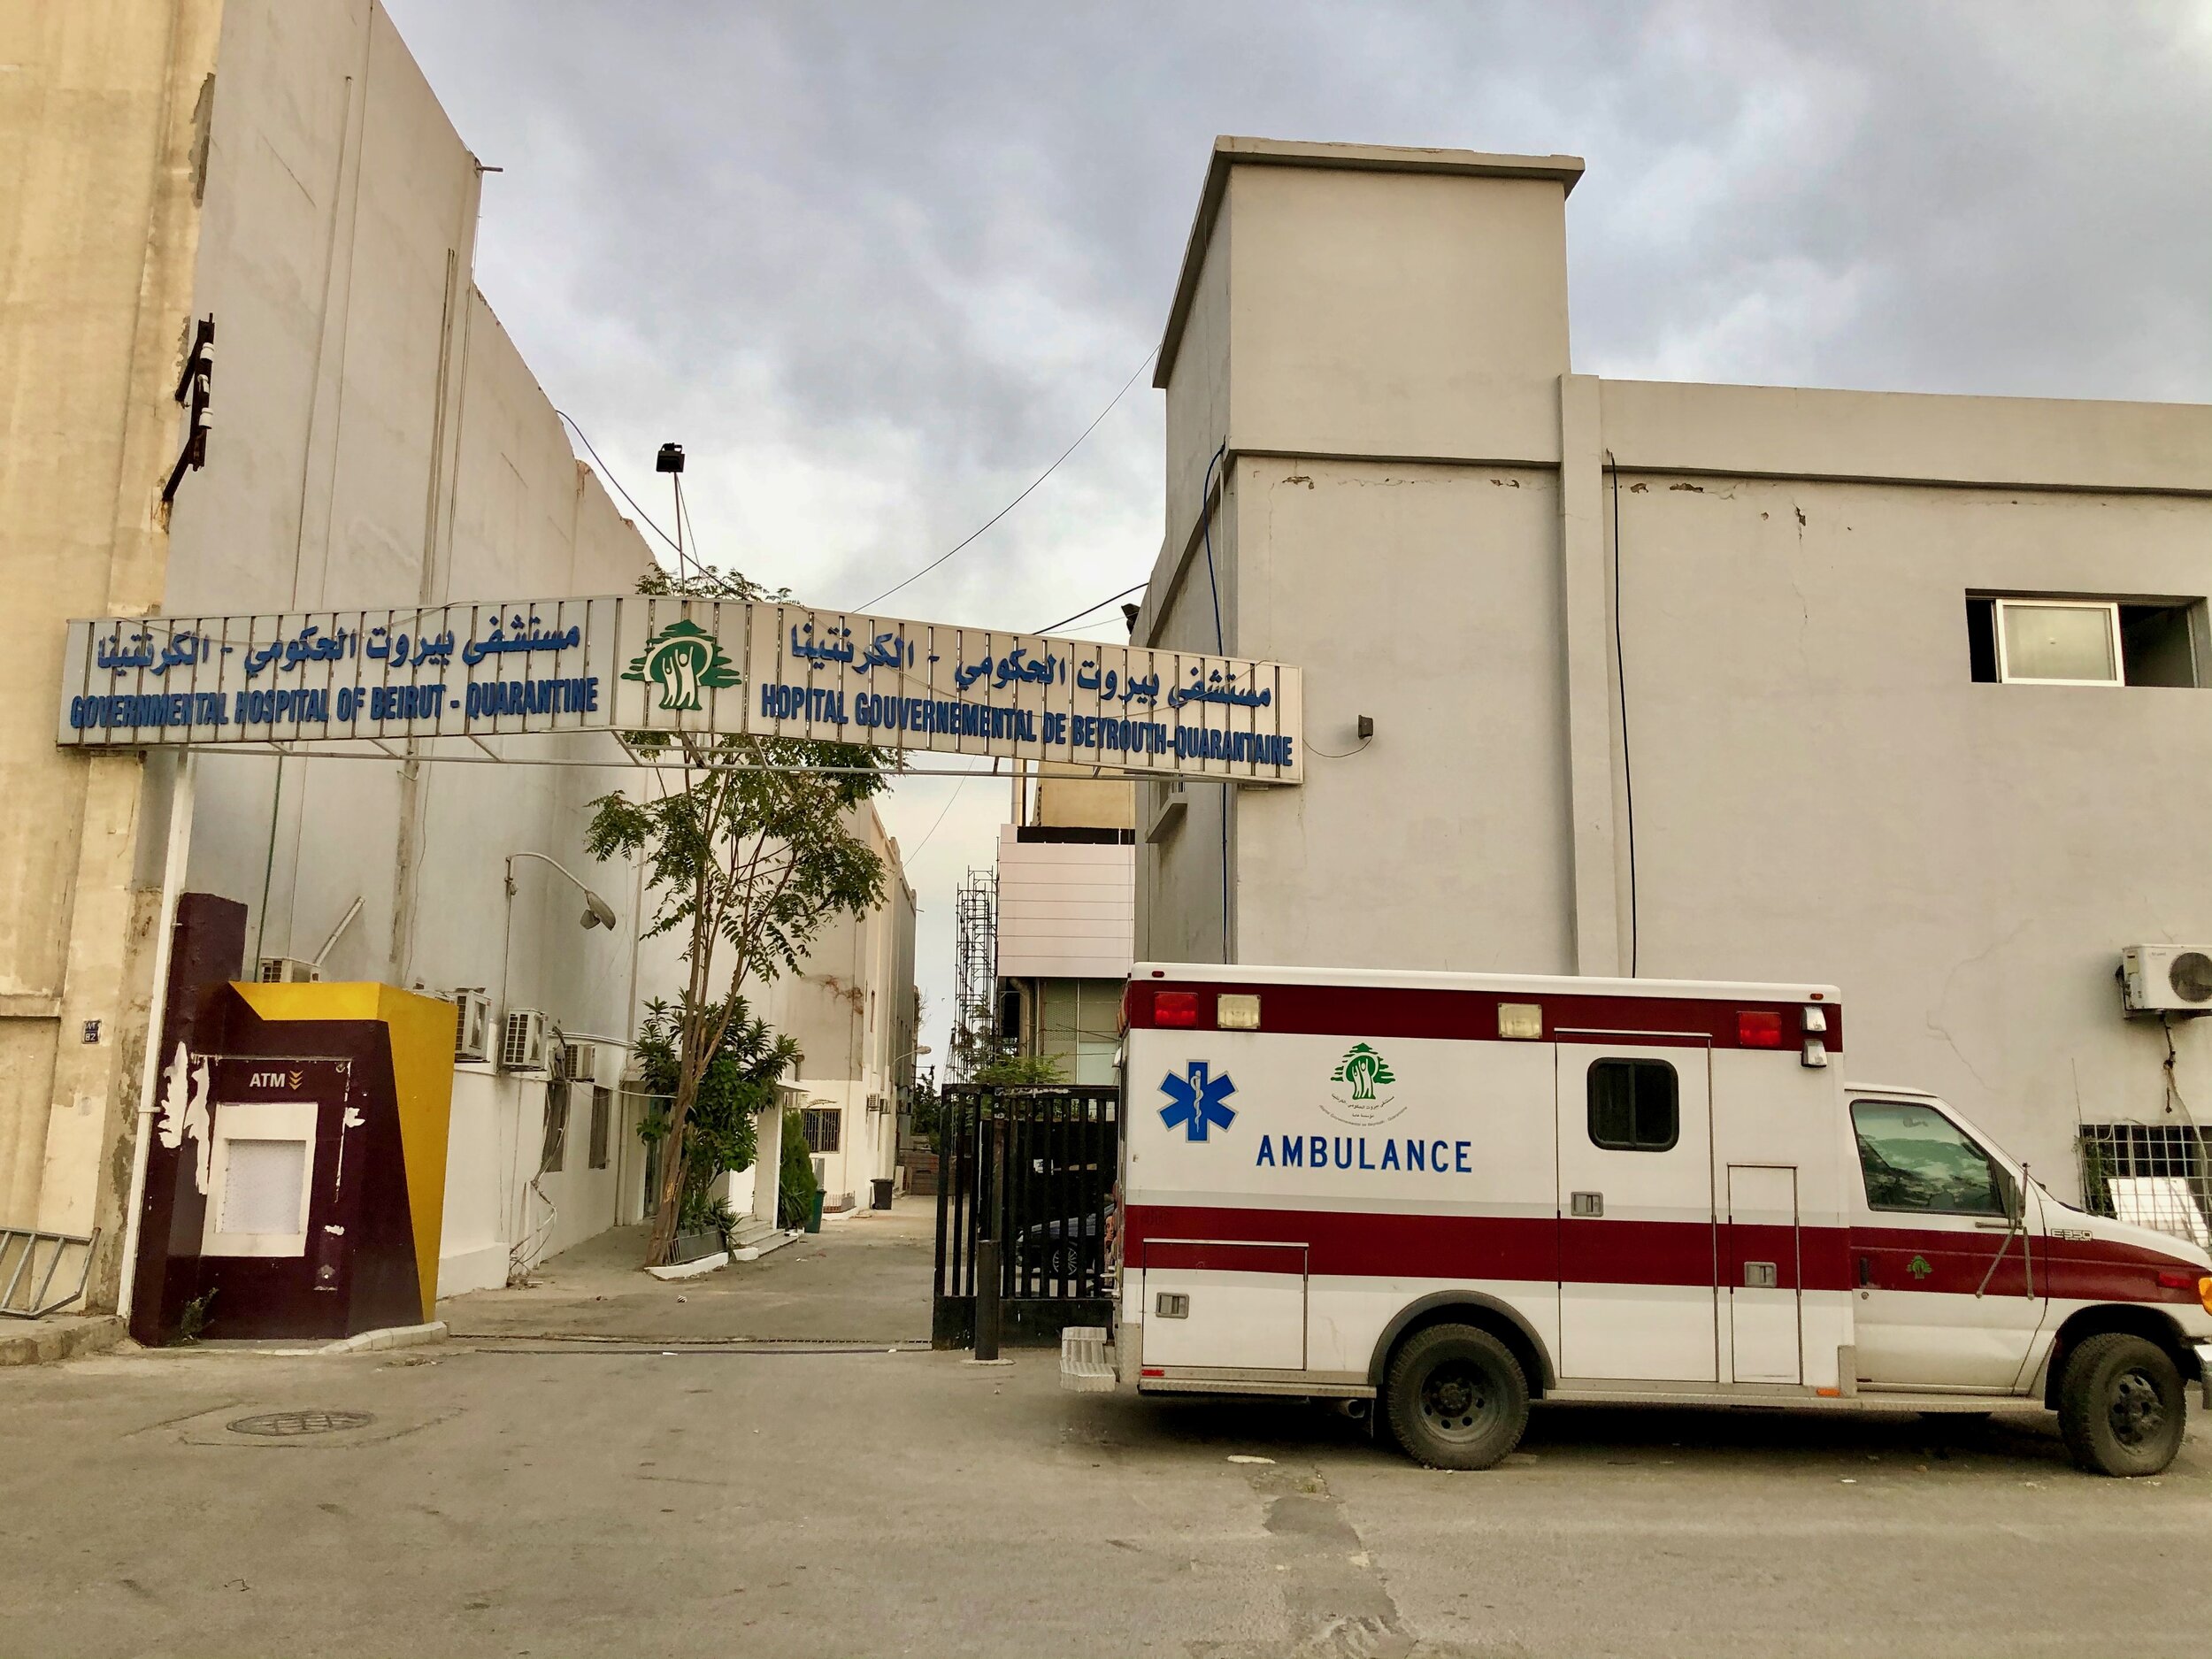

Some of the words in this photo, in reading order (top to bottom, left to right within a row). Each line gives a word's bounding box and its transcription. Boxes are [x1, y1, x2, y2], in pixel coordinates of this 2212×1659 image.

[98, 630, 210, 676] الكرنتينا
[244, 626, 357, 679] الحكومي
[366, 627, 455, 667] بيروت
[462, 614, 580, 665] مستشفى
[791, 623, 914, 674] الكرنتينا
[955, 649, 1065, 691] الحكومي
[1077, 660, 1160, 707] بيروت
[1168, 666, 1271, 709] مستشفى
[70, 692, 228, 729] GOVERNMENTAL
[234, 688, 330, 725] HOSPITAL
[337, 687, 366, 722] OF
[370, 684, 446, 720] BEIRUT
[466, 677, 598, 720] QUARANTINE
[761, 683, 849, 725] HOPITAL
[855, 692, 1037, 742] GOUVERNEMENTAL
[1043, 710, 1066, 745] DE
[249, 1072, 286, 1087] ATM
[1256, 1134, 1472, 1173] AMBULANCE
